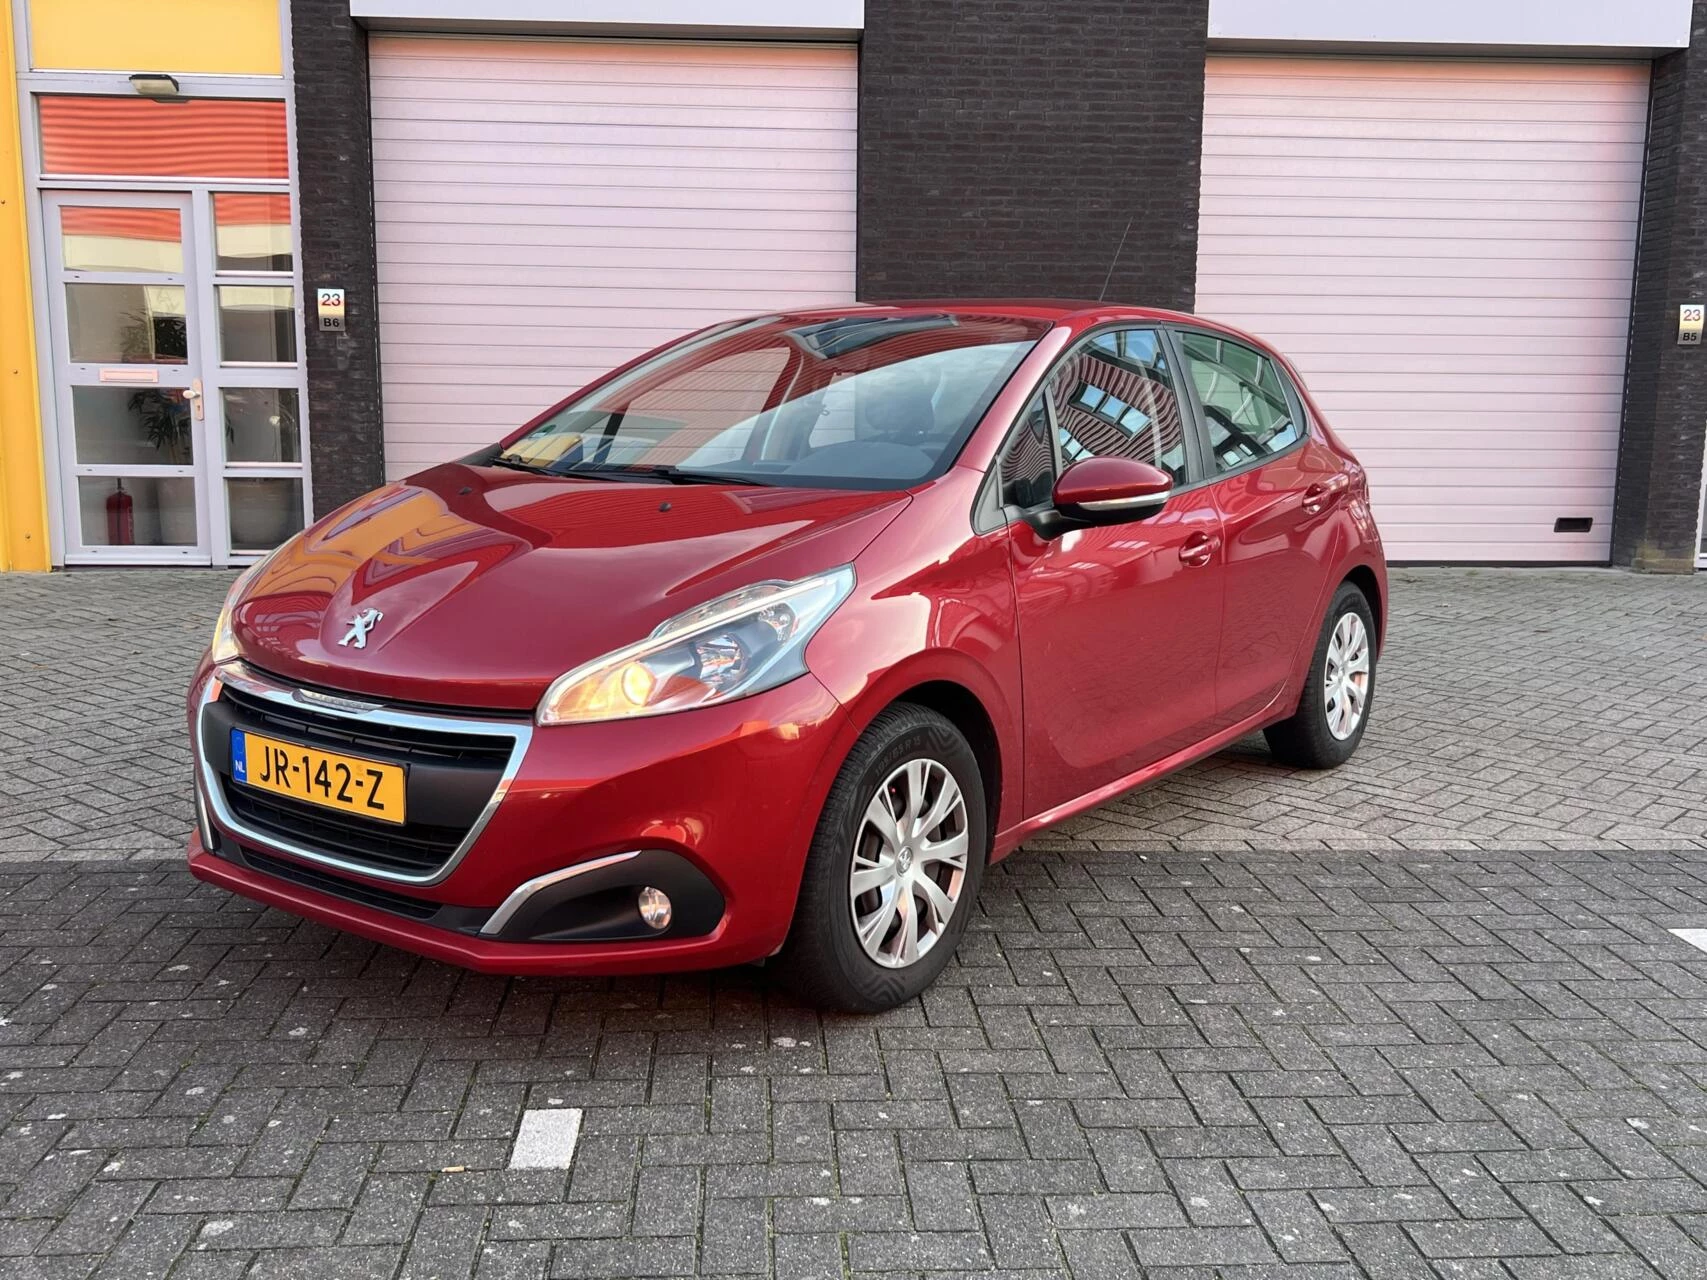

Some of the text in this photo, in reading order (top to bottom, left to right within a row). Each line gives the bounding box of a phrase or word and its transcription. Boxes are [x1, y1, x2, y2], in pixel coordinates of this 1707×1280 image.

[321, 293, 341, 306] 23
[1683, 309, 1701, 321] 23
[323, 317, 340, 327] B6
[1683, 332, 1698, 342] B5
[235, 760, 246, 773] NL
[260, 746, 384, 810] JR-142-Z
